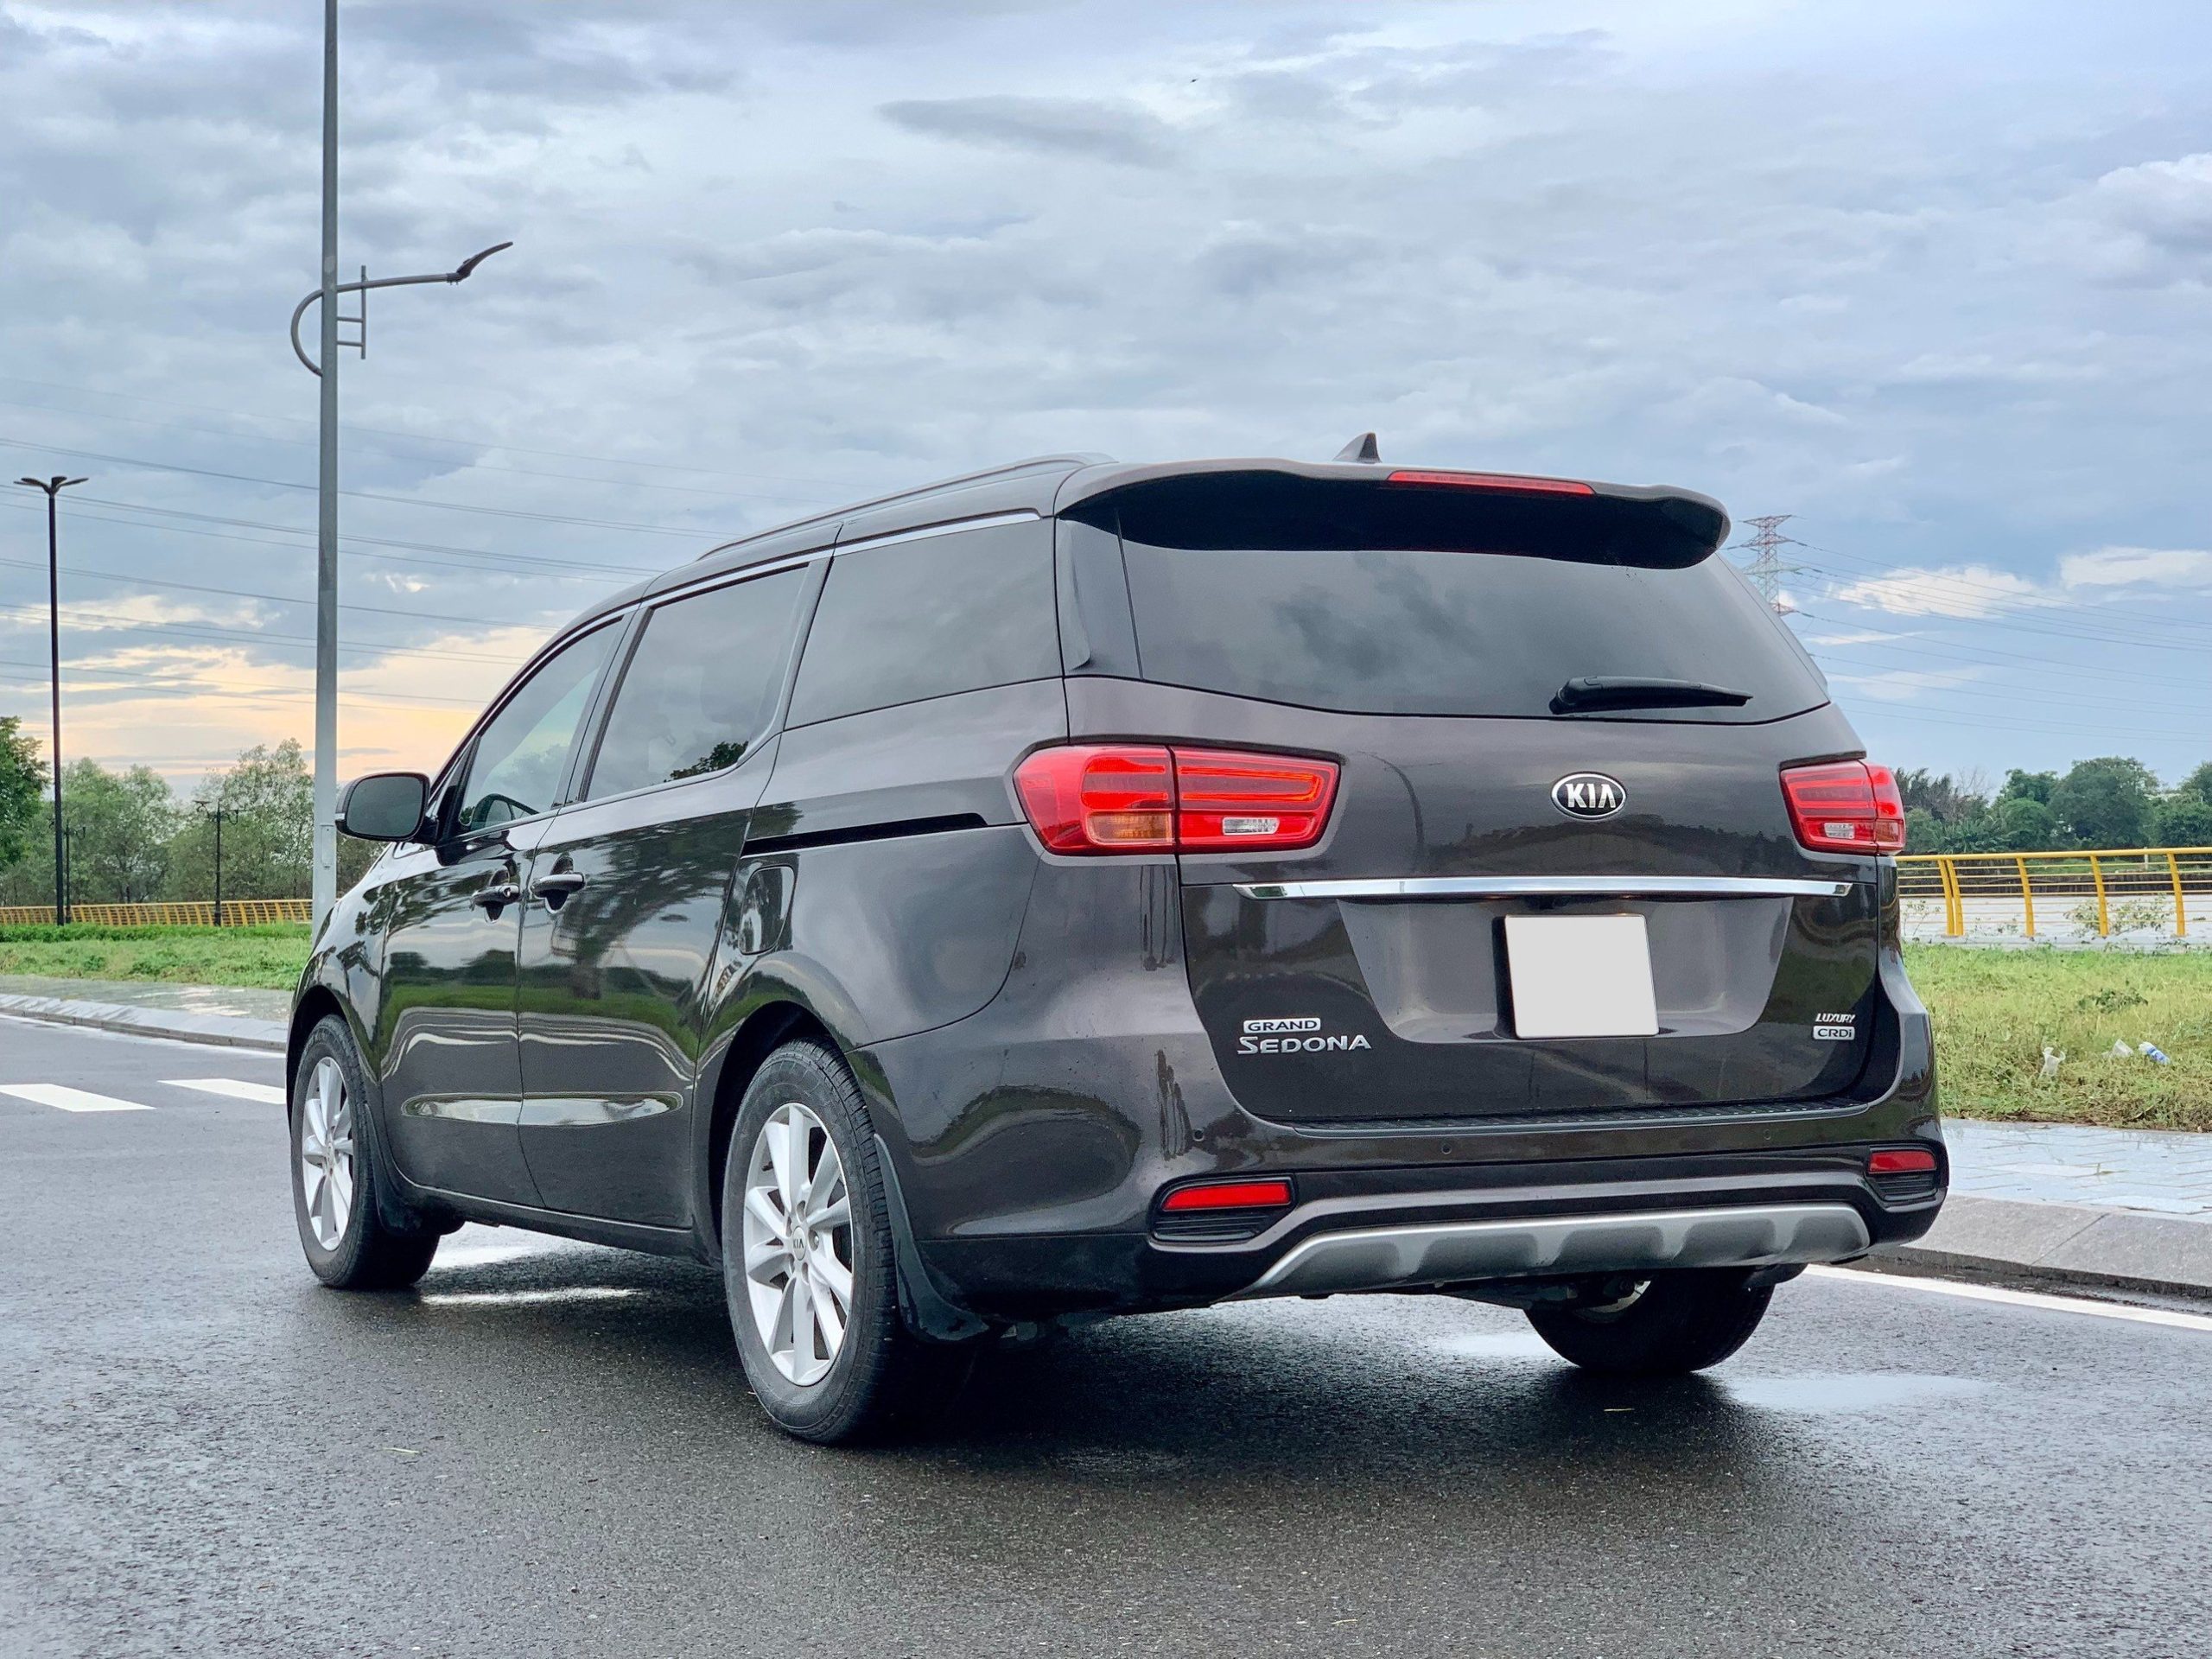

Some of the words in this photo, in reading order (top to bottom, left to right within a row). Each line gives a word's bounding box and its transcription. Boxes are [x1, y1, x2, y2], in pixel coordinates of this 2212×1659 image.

[1566, 783, 1617, 808] KIA
[1815, 1013, 1856, 1023] LUXURY
[1247, 1020, 1318, 1032] GRAND
[1817, 1028, 1852, 1038] CRDi
[1237, 1034, 1372, 1055] SEDONA
